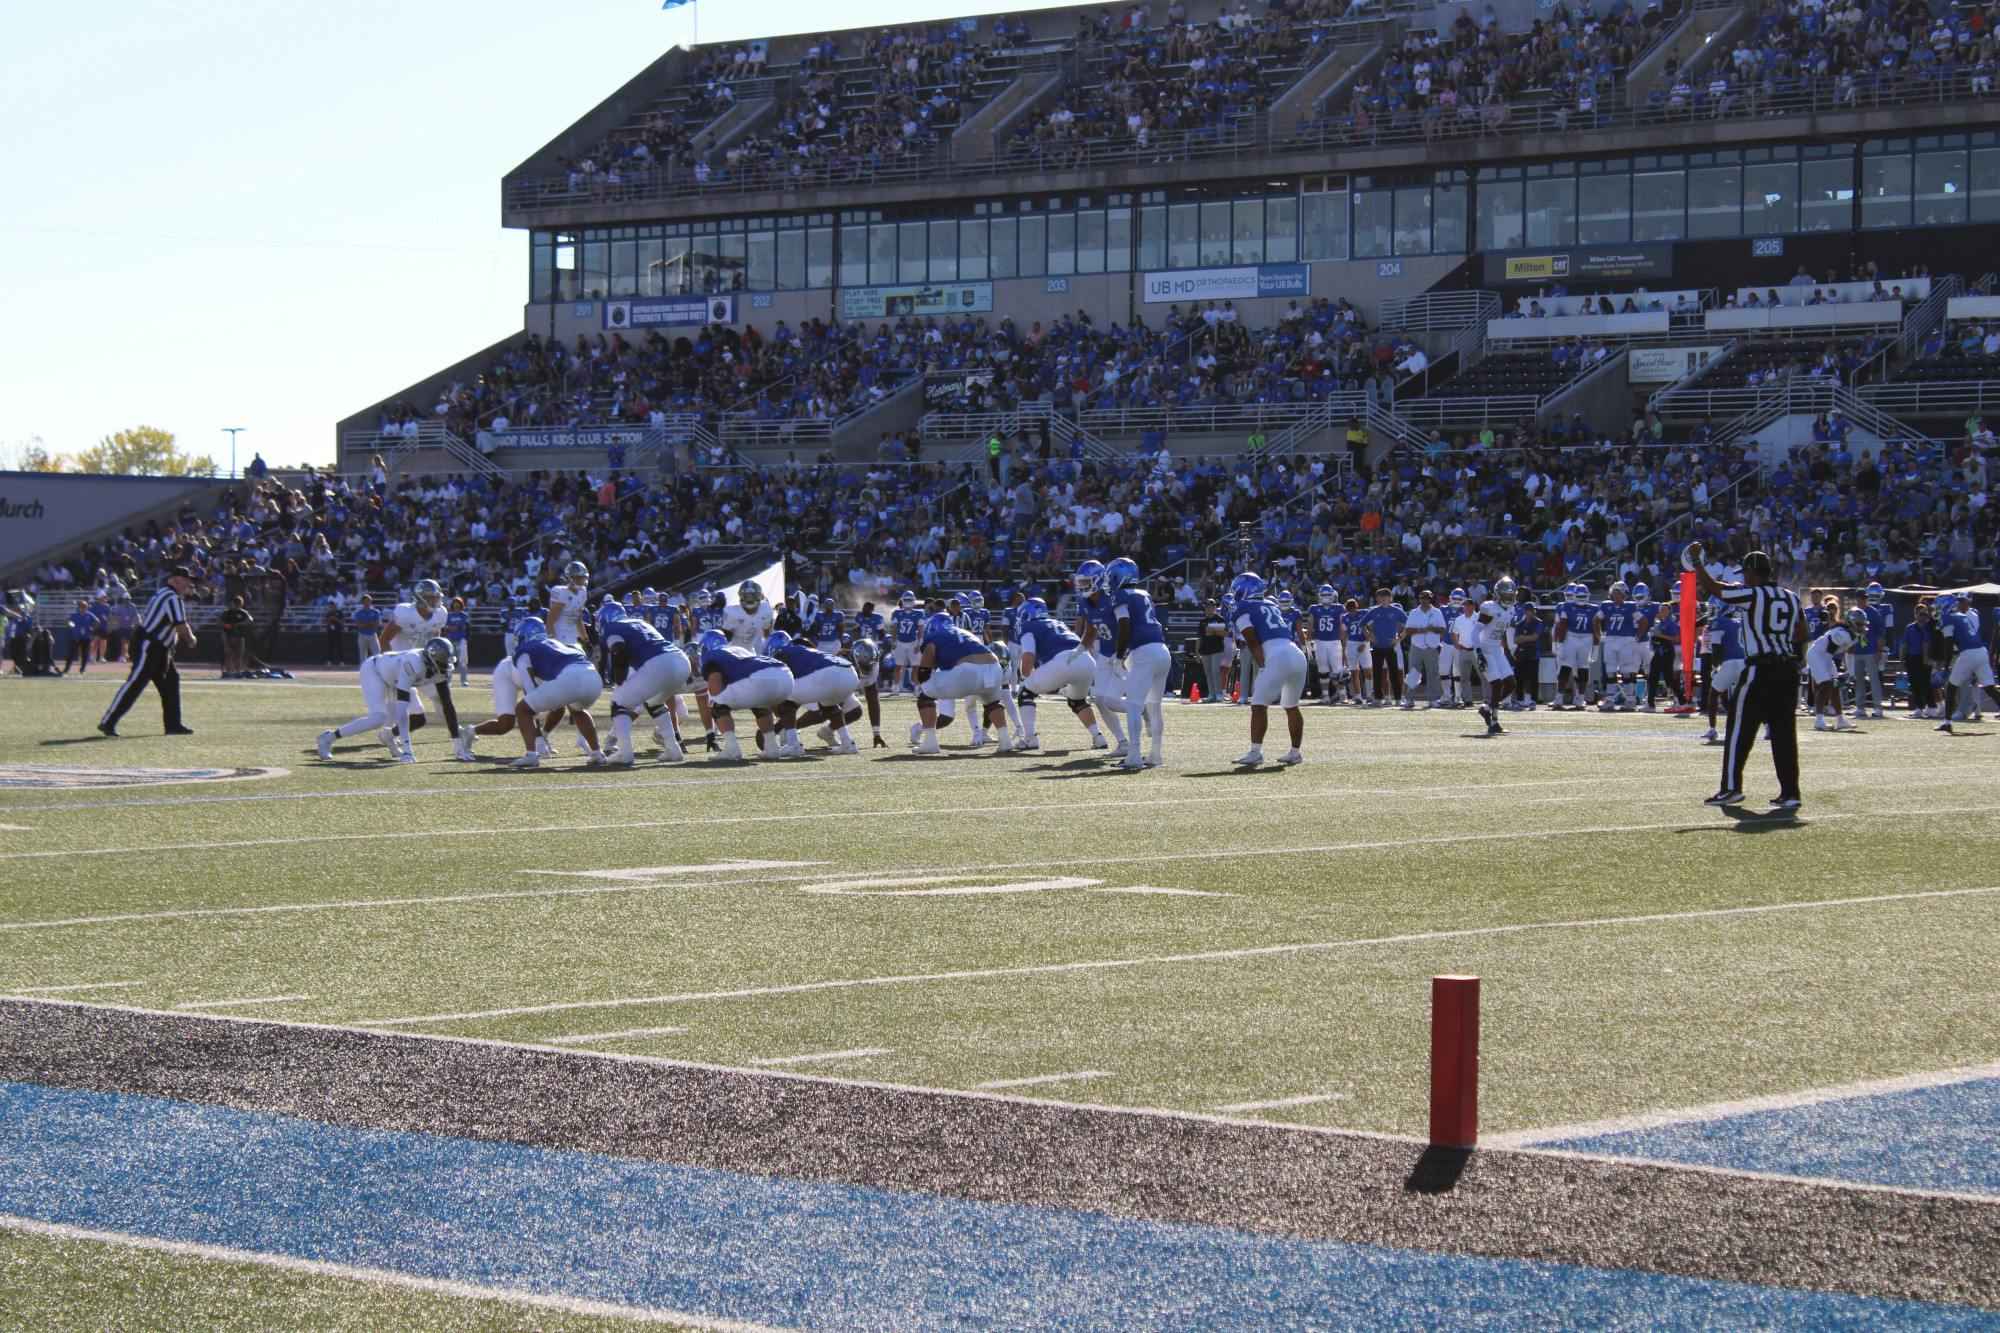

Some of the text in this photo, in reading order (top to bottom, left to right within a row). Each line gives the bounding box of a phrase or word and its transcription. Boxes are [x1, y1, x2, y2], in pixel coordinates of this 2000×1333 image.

[1756, 240, 1781, 255] 205
[1380, 263, 1400, 276] 204
[1514, 260, 1567, 273] Milton CAT
[1047, 279, 1066, 292] 203
[1151, 280, 1195, 295] UB MD
[1196, 276, 1256, 286] ORTHOPAEDICS
[1259, 280, 1275, 290] Your
[1287, 279, 1303, 289] Bulls
[753, 295, 771, 308] 202
[520, 434, 549, 447] BULLS
[552, 433, 576, 446] KIDS
[577, 432, 601, 446] CLUB
[603, 431, 643, 445] STION
[655, 616, 669, 629] 66
[1769, 601, 1789, 631] C
[900, 621, 914, 634] 57
[973, 620, 985, 633] 29
[1318, 618, 1334, 632] 65
[1576, 617, 1588, 630] 71
[1610, 617, 1625, 630] 77
